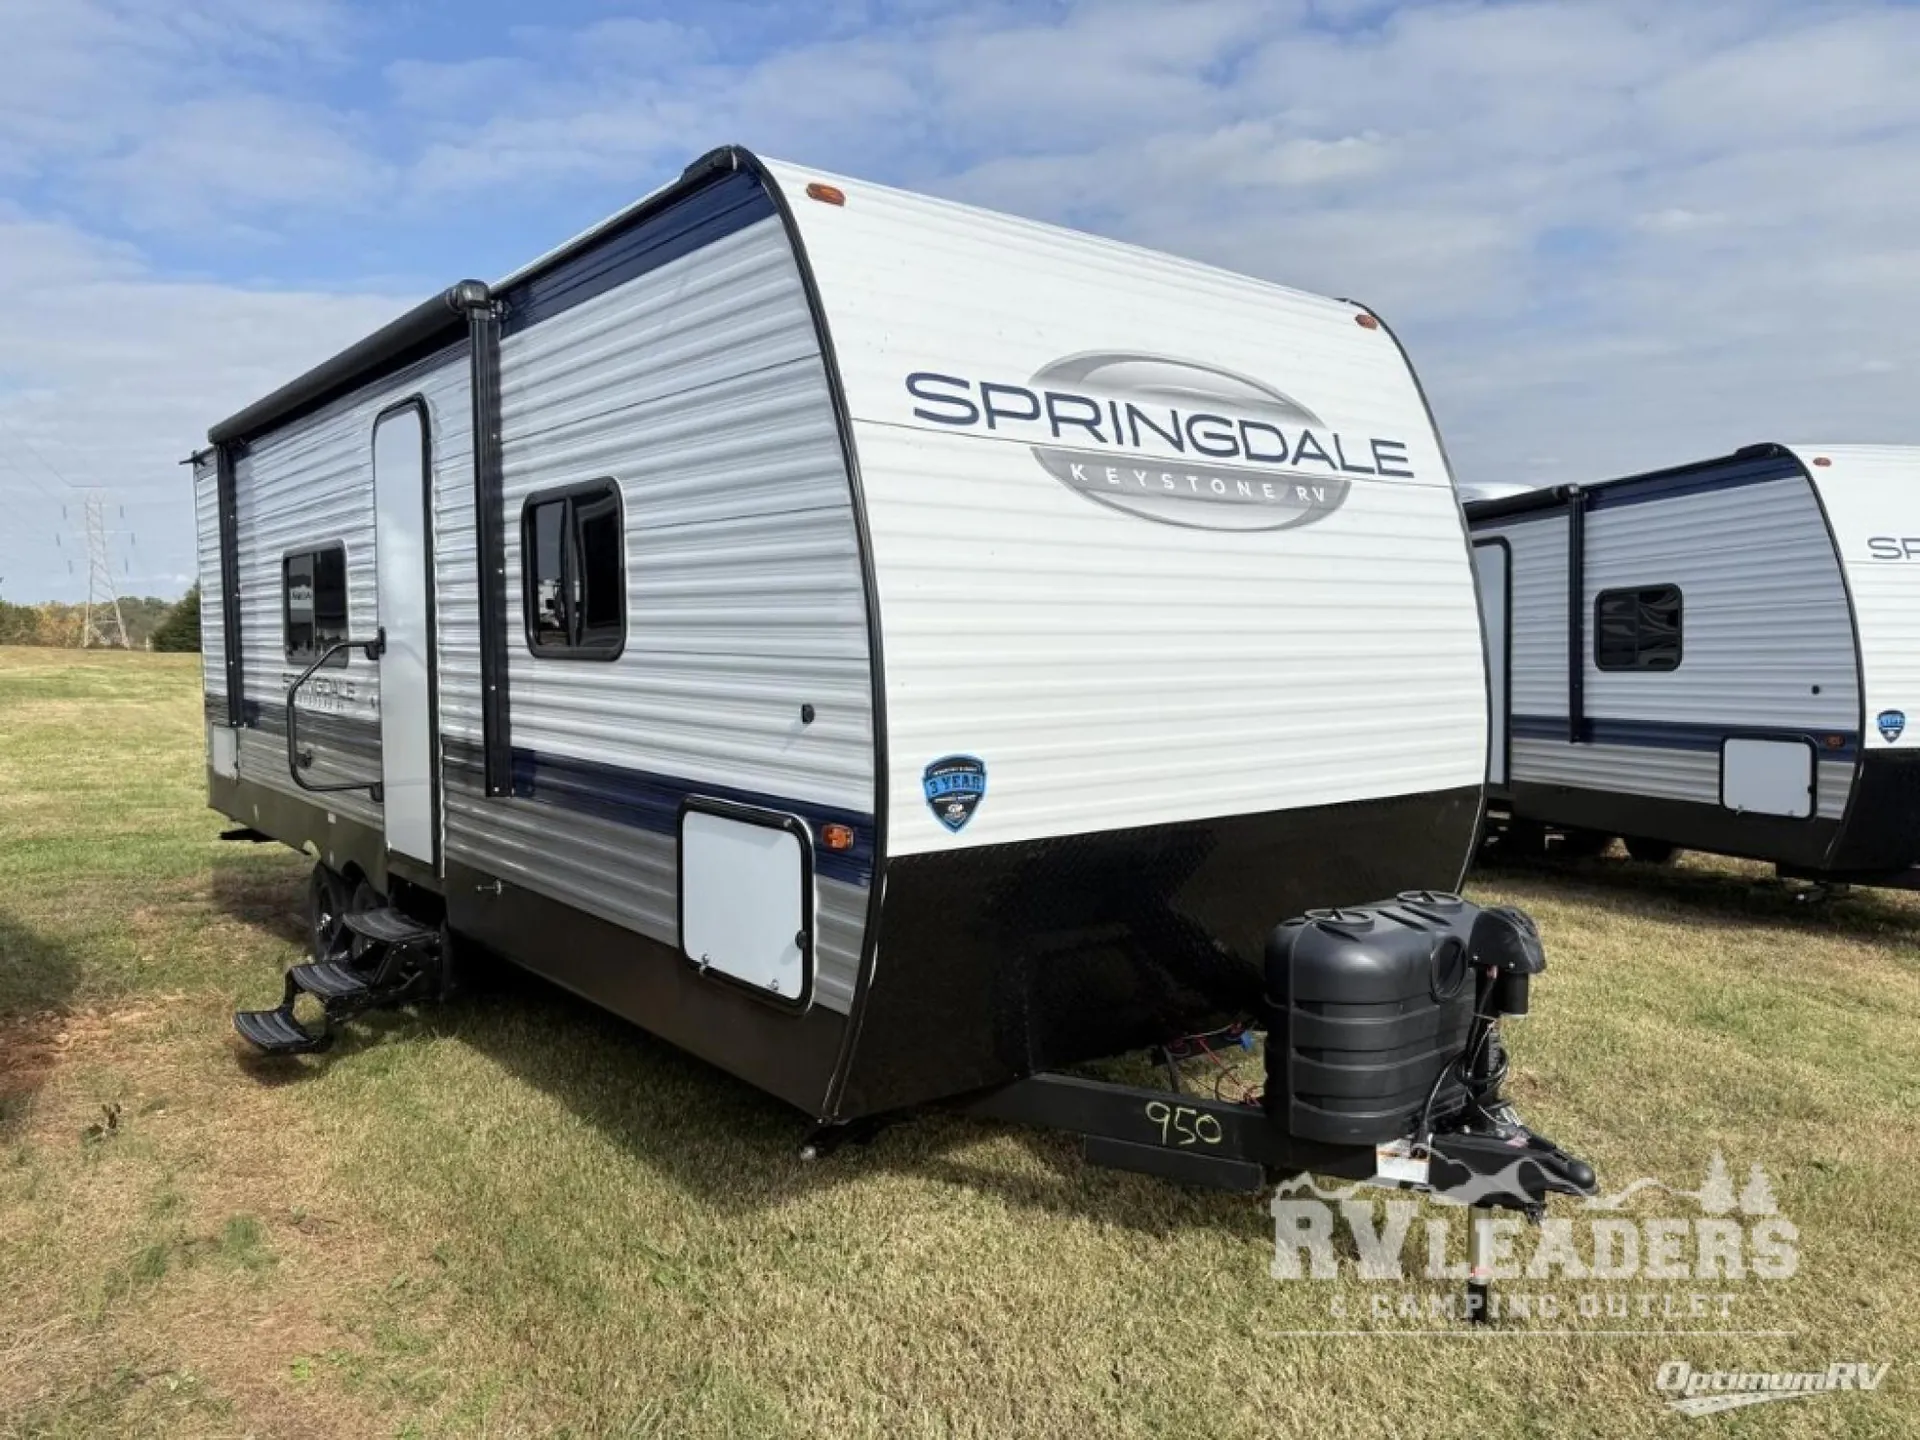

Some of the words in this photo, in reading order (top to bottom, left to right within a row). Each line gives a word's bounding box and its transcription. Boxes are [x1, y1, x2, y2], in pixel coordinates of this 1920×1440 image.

[905, 371, 1415, 479] SPRINGDALE
[1070, 462, 1277, 499] KEYSTONE
[1296, 485, 1326, 503] RV
[1145, 1101, 1222, 1146] 950
